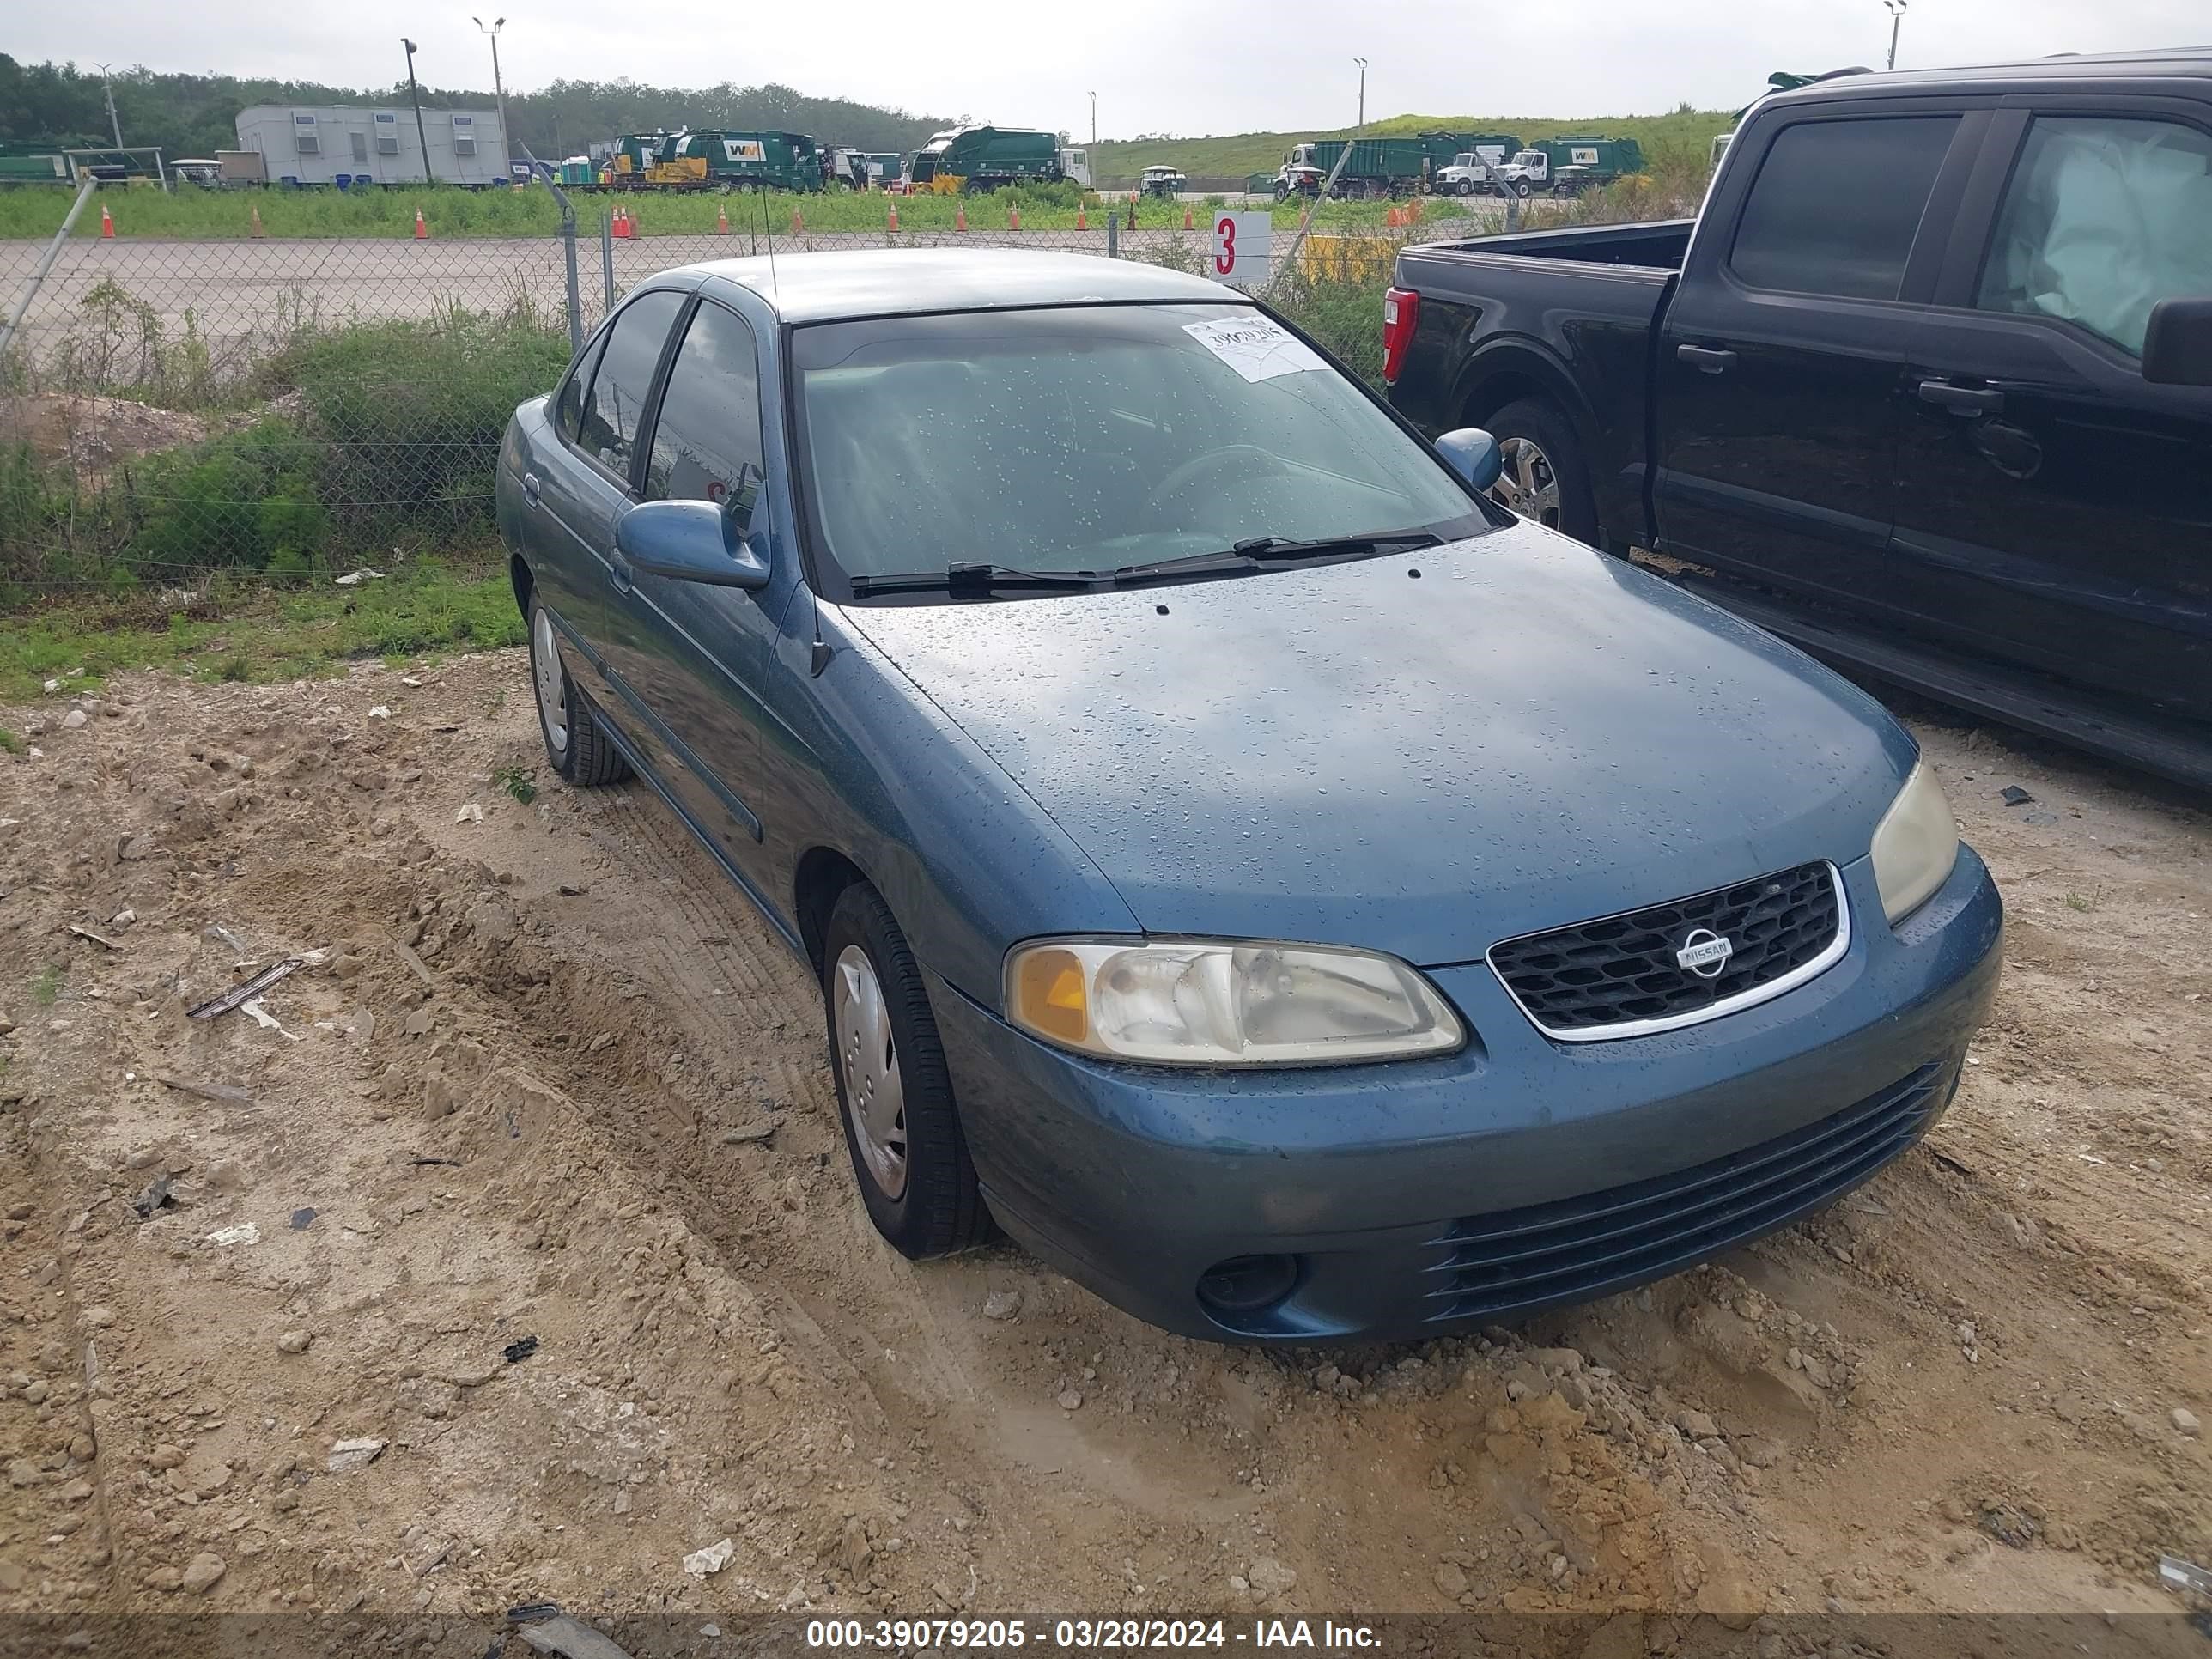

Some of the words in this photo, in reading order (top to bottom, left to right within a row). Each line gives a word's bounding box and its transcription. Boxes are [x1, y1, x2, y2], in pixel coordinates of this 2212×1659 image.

[730, 144, 761, 156] WM
[1575, 151, 1595, 160] WM
[1216, 217, 1236, 276] 3
[1685, 942, 1728, 963] NISSAN
